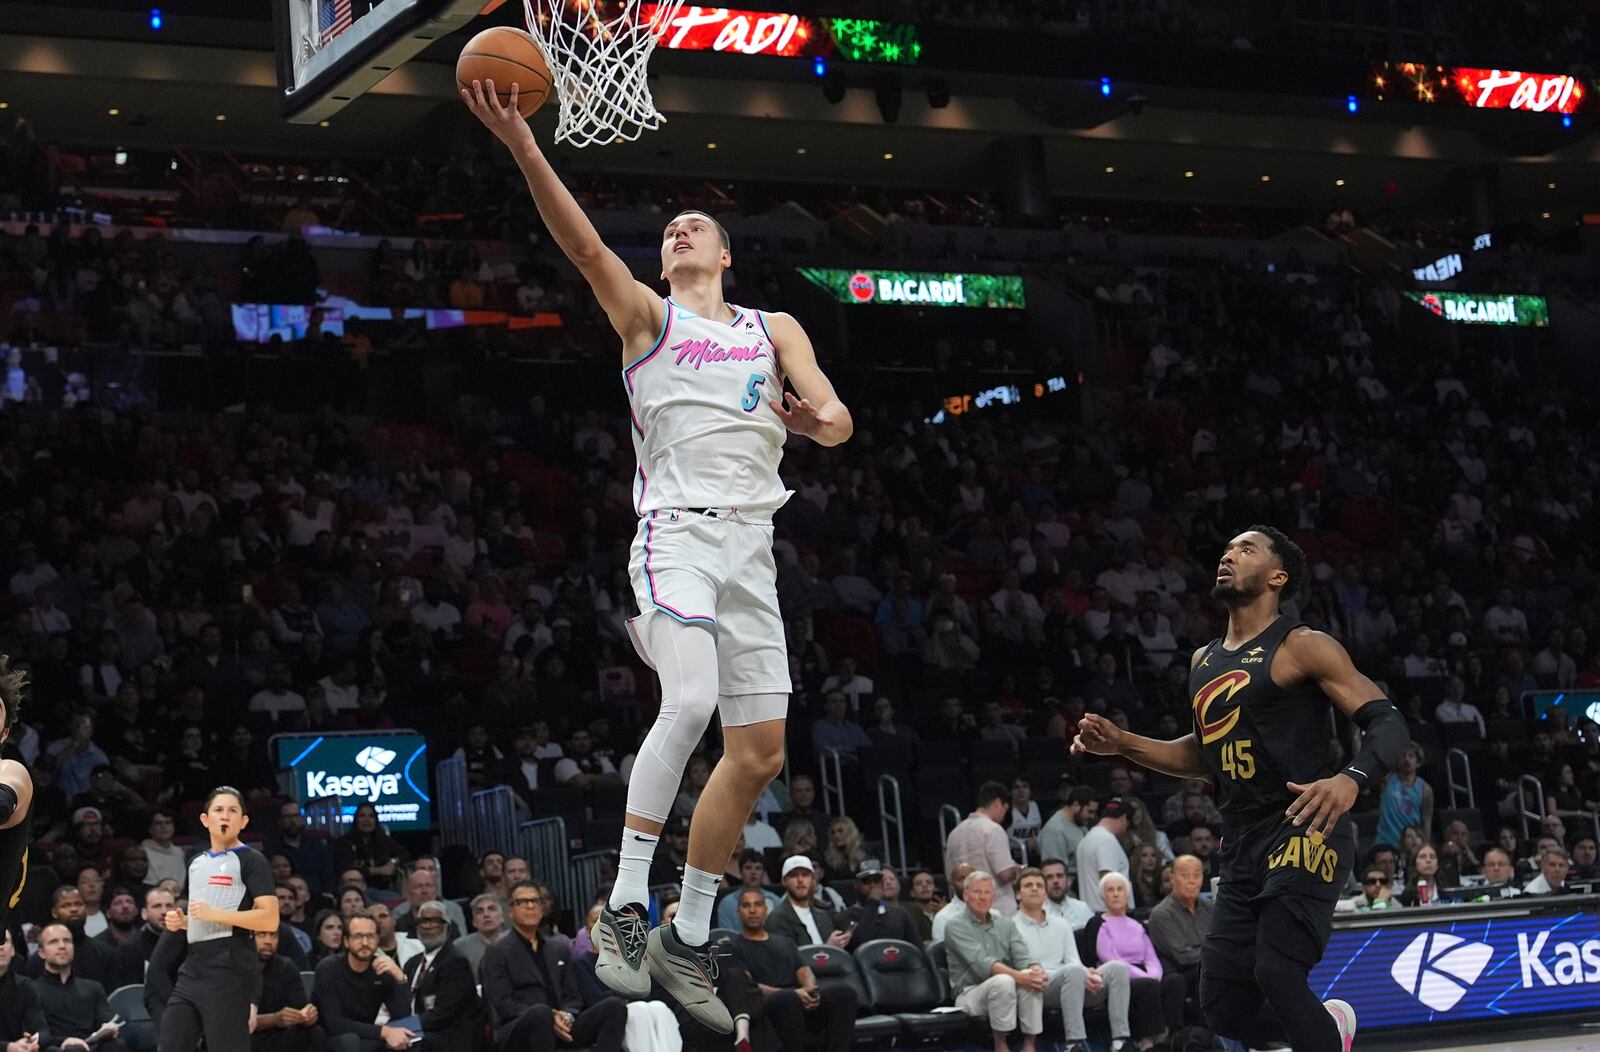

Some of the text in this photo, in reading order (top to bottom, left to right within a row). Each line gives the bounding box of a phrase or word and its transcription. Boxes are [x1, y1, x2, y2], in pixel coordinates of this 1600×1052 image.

[878, 275, 965, 303] BACARDÍ
[670, 338, 767, 370] Miami
[741, 373, 765, 412] 5
[1193, 669, 1251, 745] C
[1221, 739, 1256, 780] 45
[306, 770, 399, 802] Kaseya
[1268, 833, 1338, 882] CAVS
[1517, 930, 1600, 988] Kas
